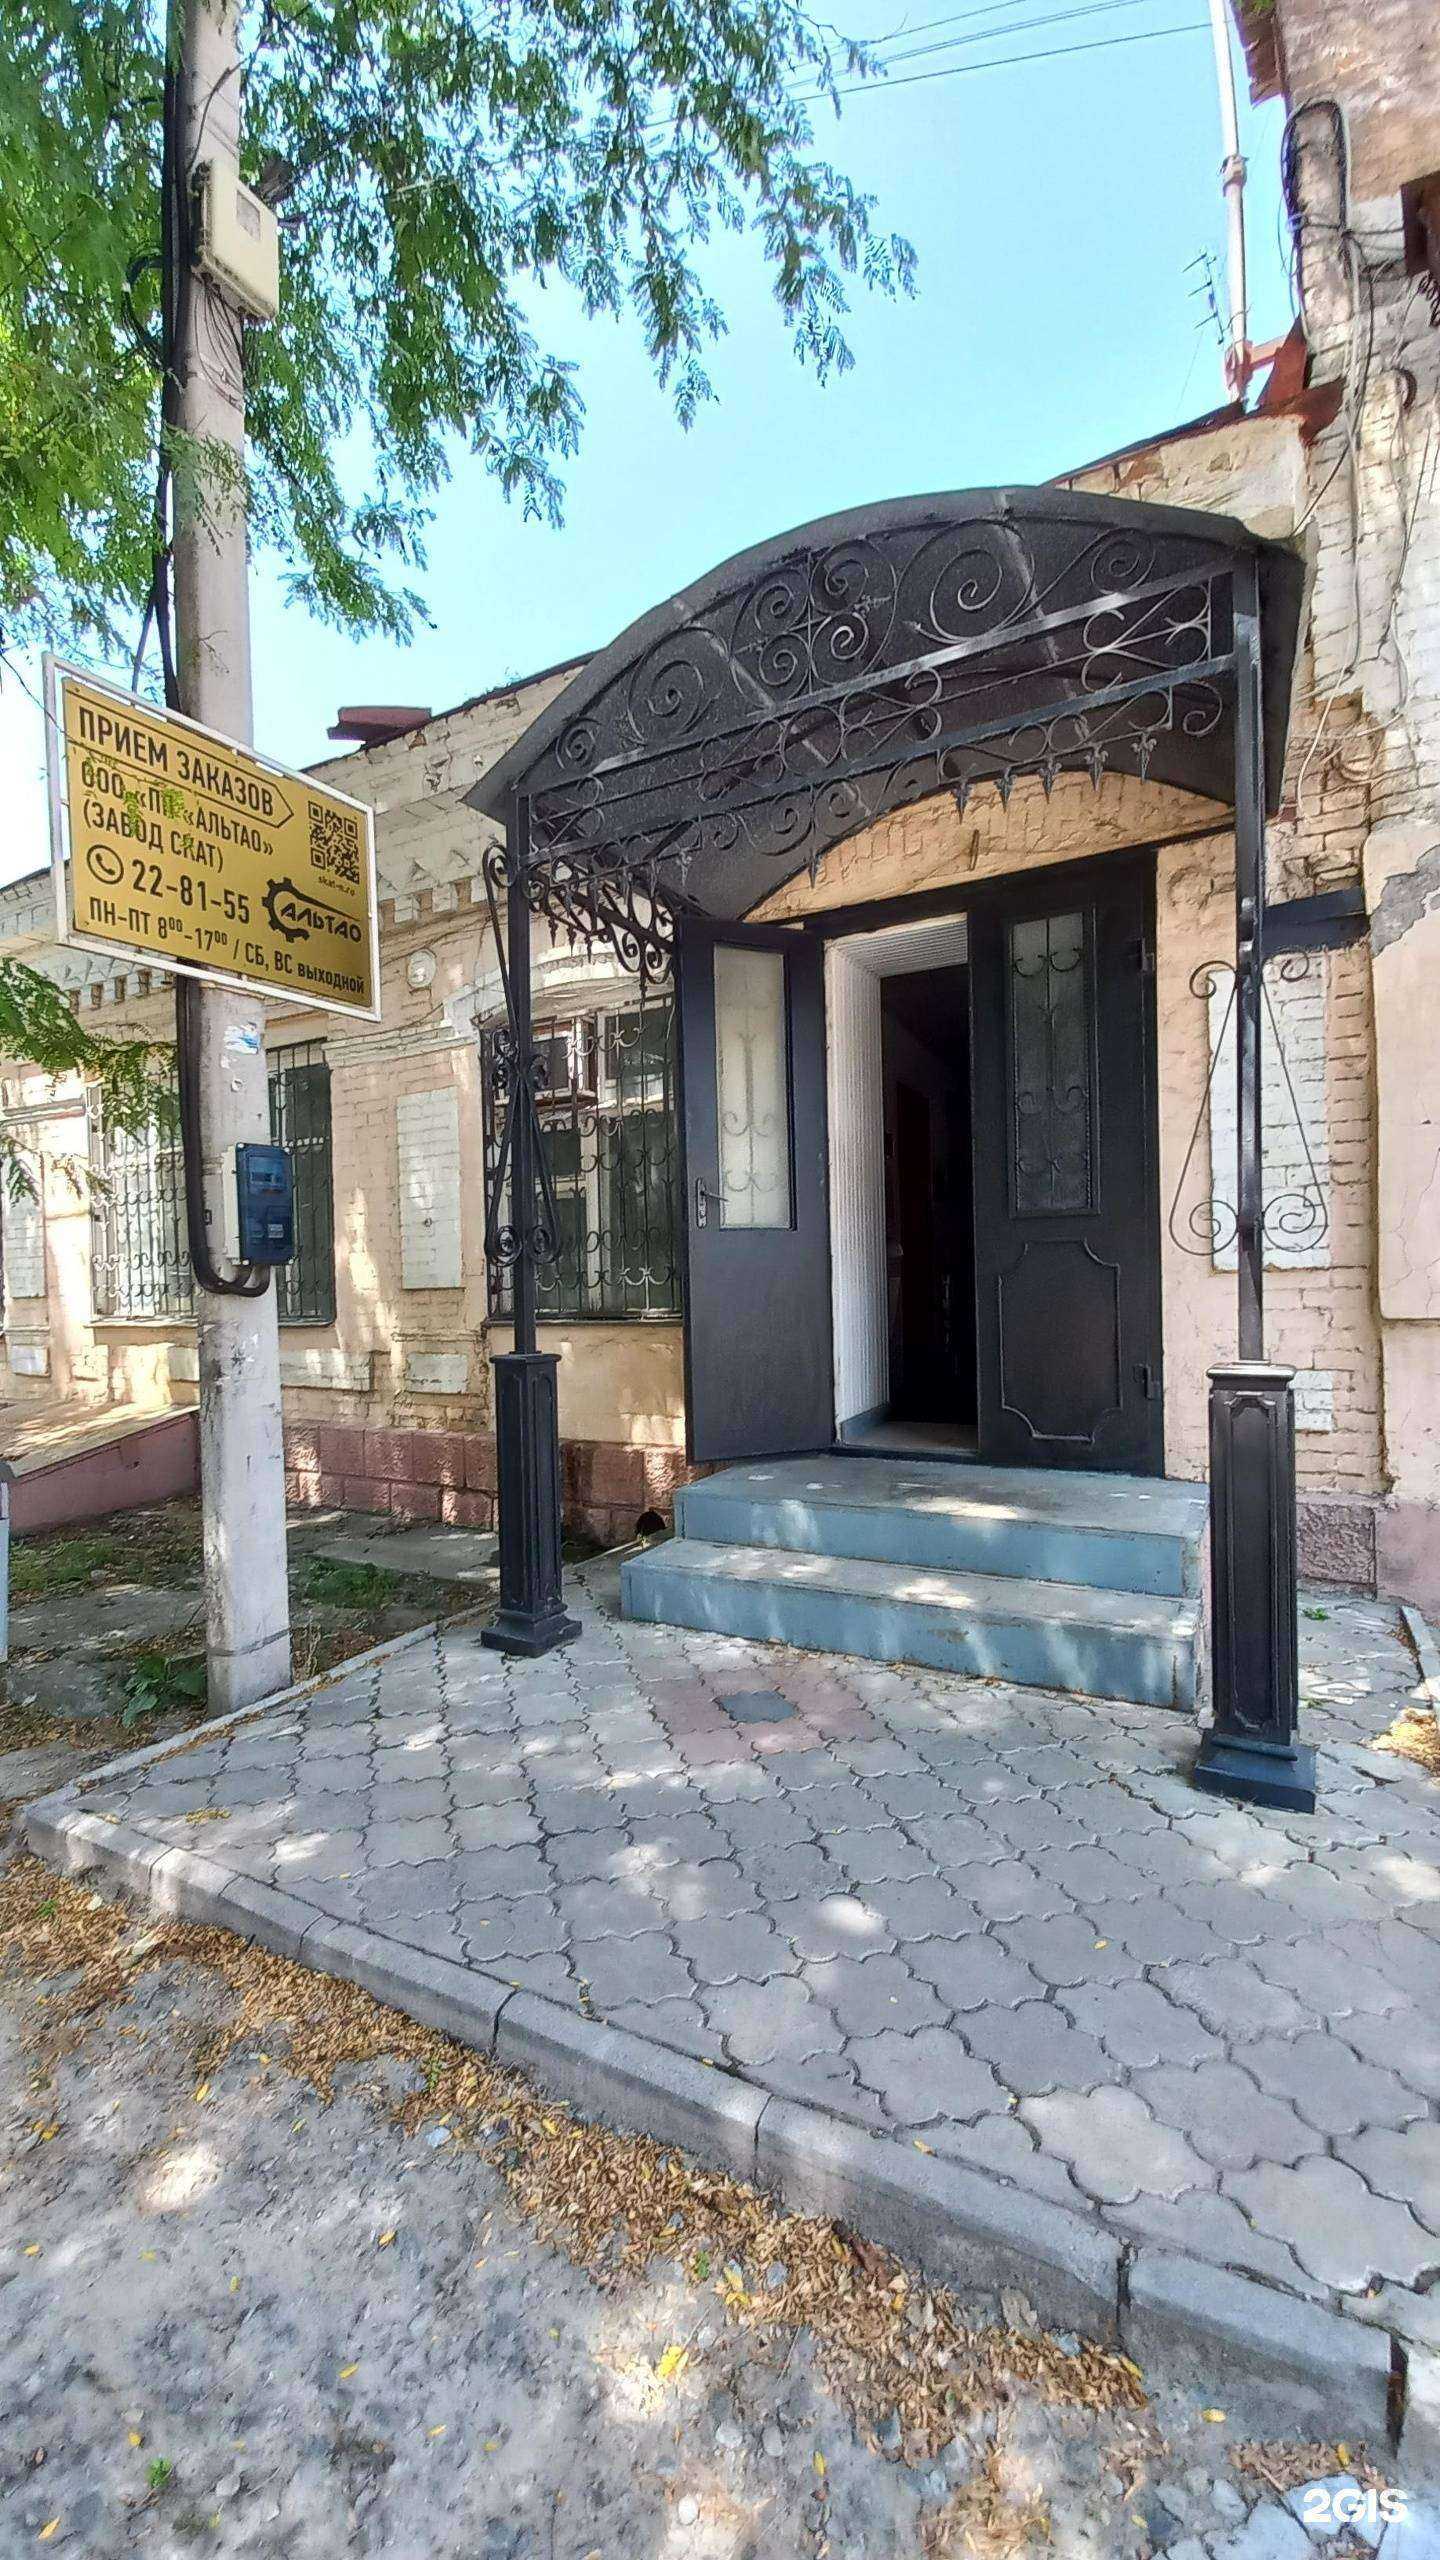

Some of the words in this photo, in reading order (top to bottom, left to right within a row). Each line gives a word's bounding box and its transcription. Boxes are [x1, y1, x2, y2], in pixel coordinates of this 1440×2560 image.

[79, 706, 168, 772] ПРИЕМ
[177, 750, 274, 817] ЗАКАЗОВ
[81, 760, 124, 799] ООО
[184, 806, 274, 856] «АЛЬТАО»
[132, 858, 250, 924] 22-81-55
[281, 902, 362, 943] АЛЬТАО
[90, 896, 151, 935] ПН-ПТ
[245, 942, 269, 971] СБ,
[274, 950, 293, 974] ВС
